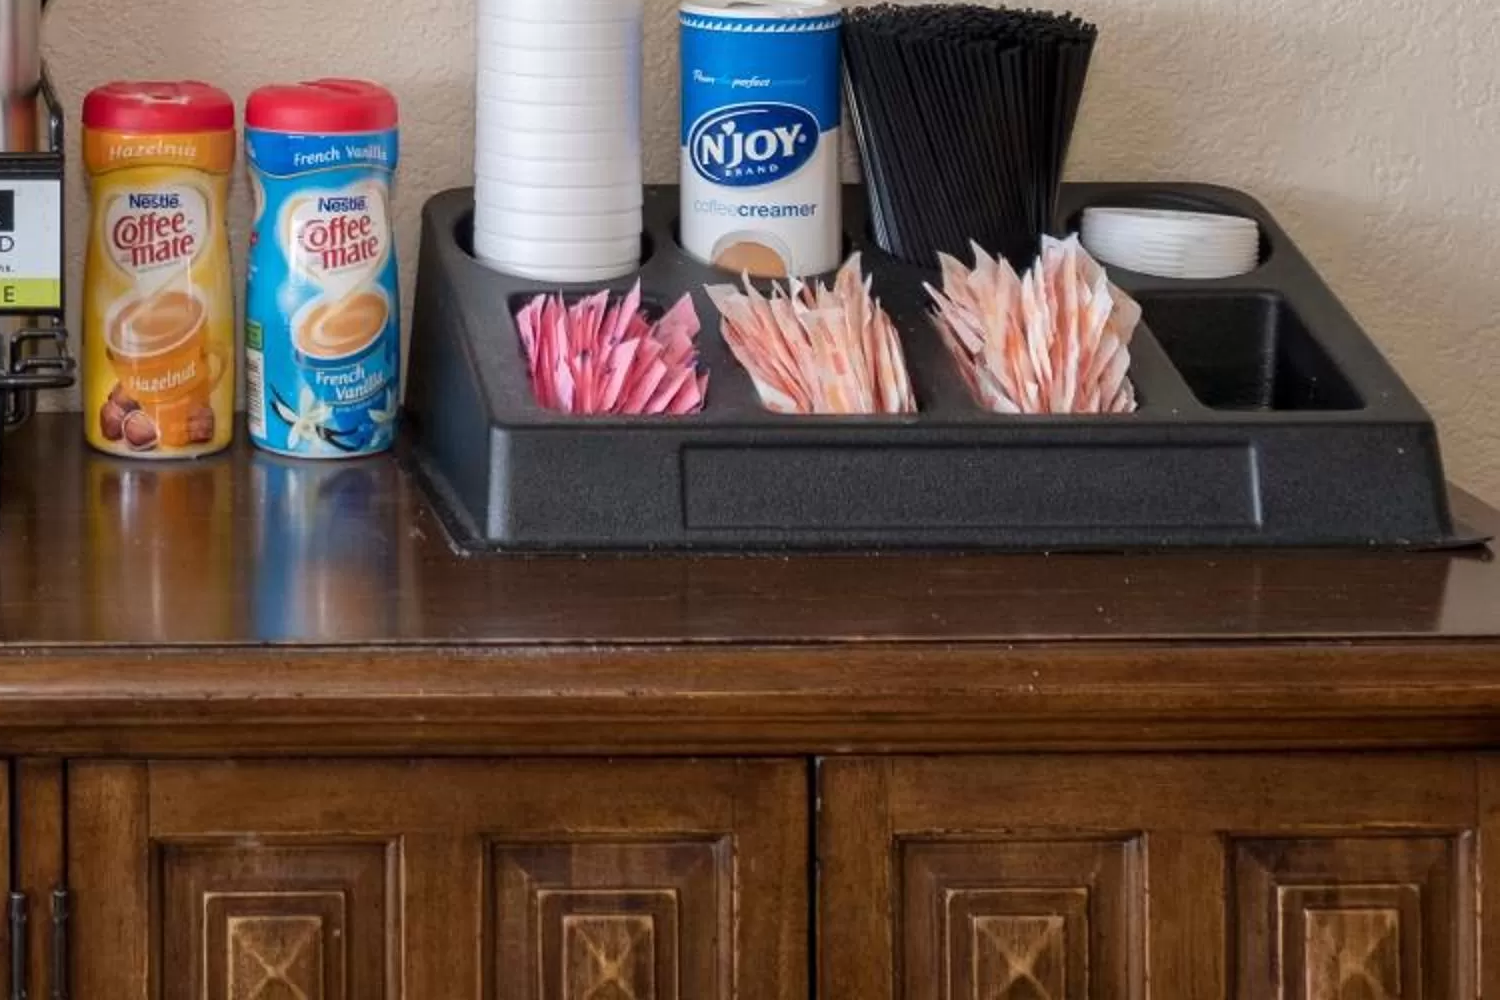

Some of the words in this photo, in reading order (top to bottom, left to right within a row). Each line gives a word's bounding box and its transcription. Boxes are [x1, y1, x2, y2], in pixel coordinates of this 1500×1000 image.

[108, 139, 198, 161] Hazelnut
[293, 145, 341, 167] French
[345, 144, 388, 161] Vanilla
[724, 164, 780, 178] BRAND
[113, 211, 186, 250] Coffee
[303, 214, 372, 253] Coffee
[131, 234, 195, 267] mate
[322, 235, 379, 269] mate
[128, 360, 197, 392] Hazelnut
[315, 362, 366, 385] French
[335, 370, 385, 400] Vanilla
